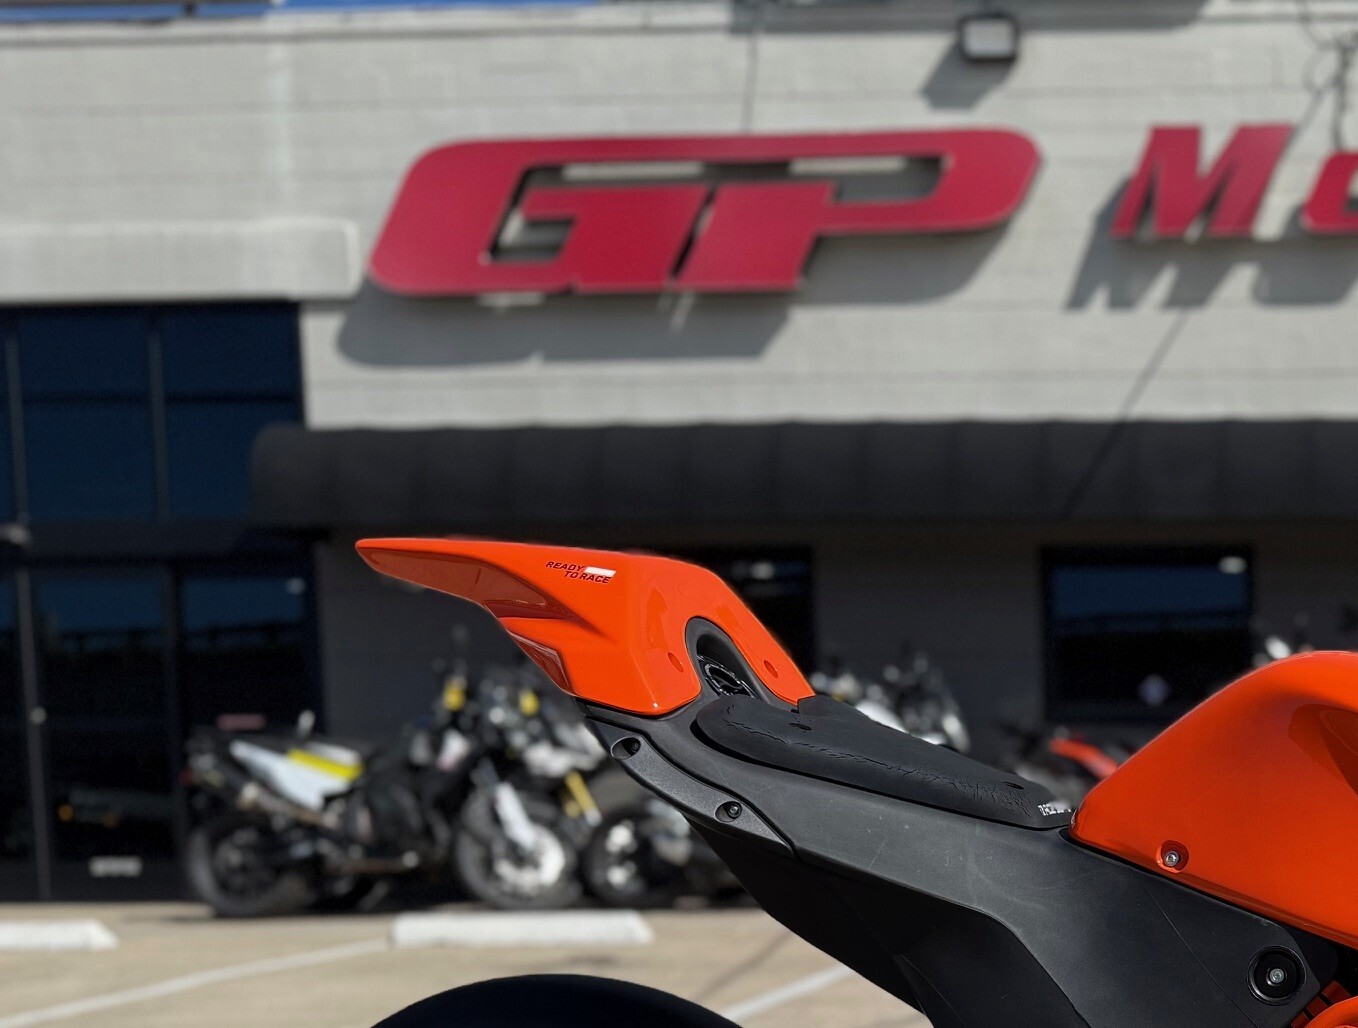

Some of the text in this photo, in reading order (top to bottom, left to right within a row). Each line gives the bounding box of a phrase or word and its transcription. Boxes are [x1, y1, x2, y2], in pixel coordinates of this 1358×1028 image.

[368, 125, 1045, 295] GP
[546, 561, 585, 572] READY
[564, 571, 612, 584] TO RACE
